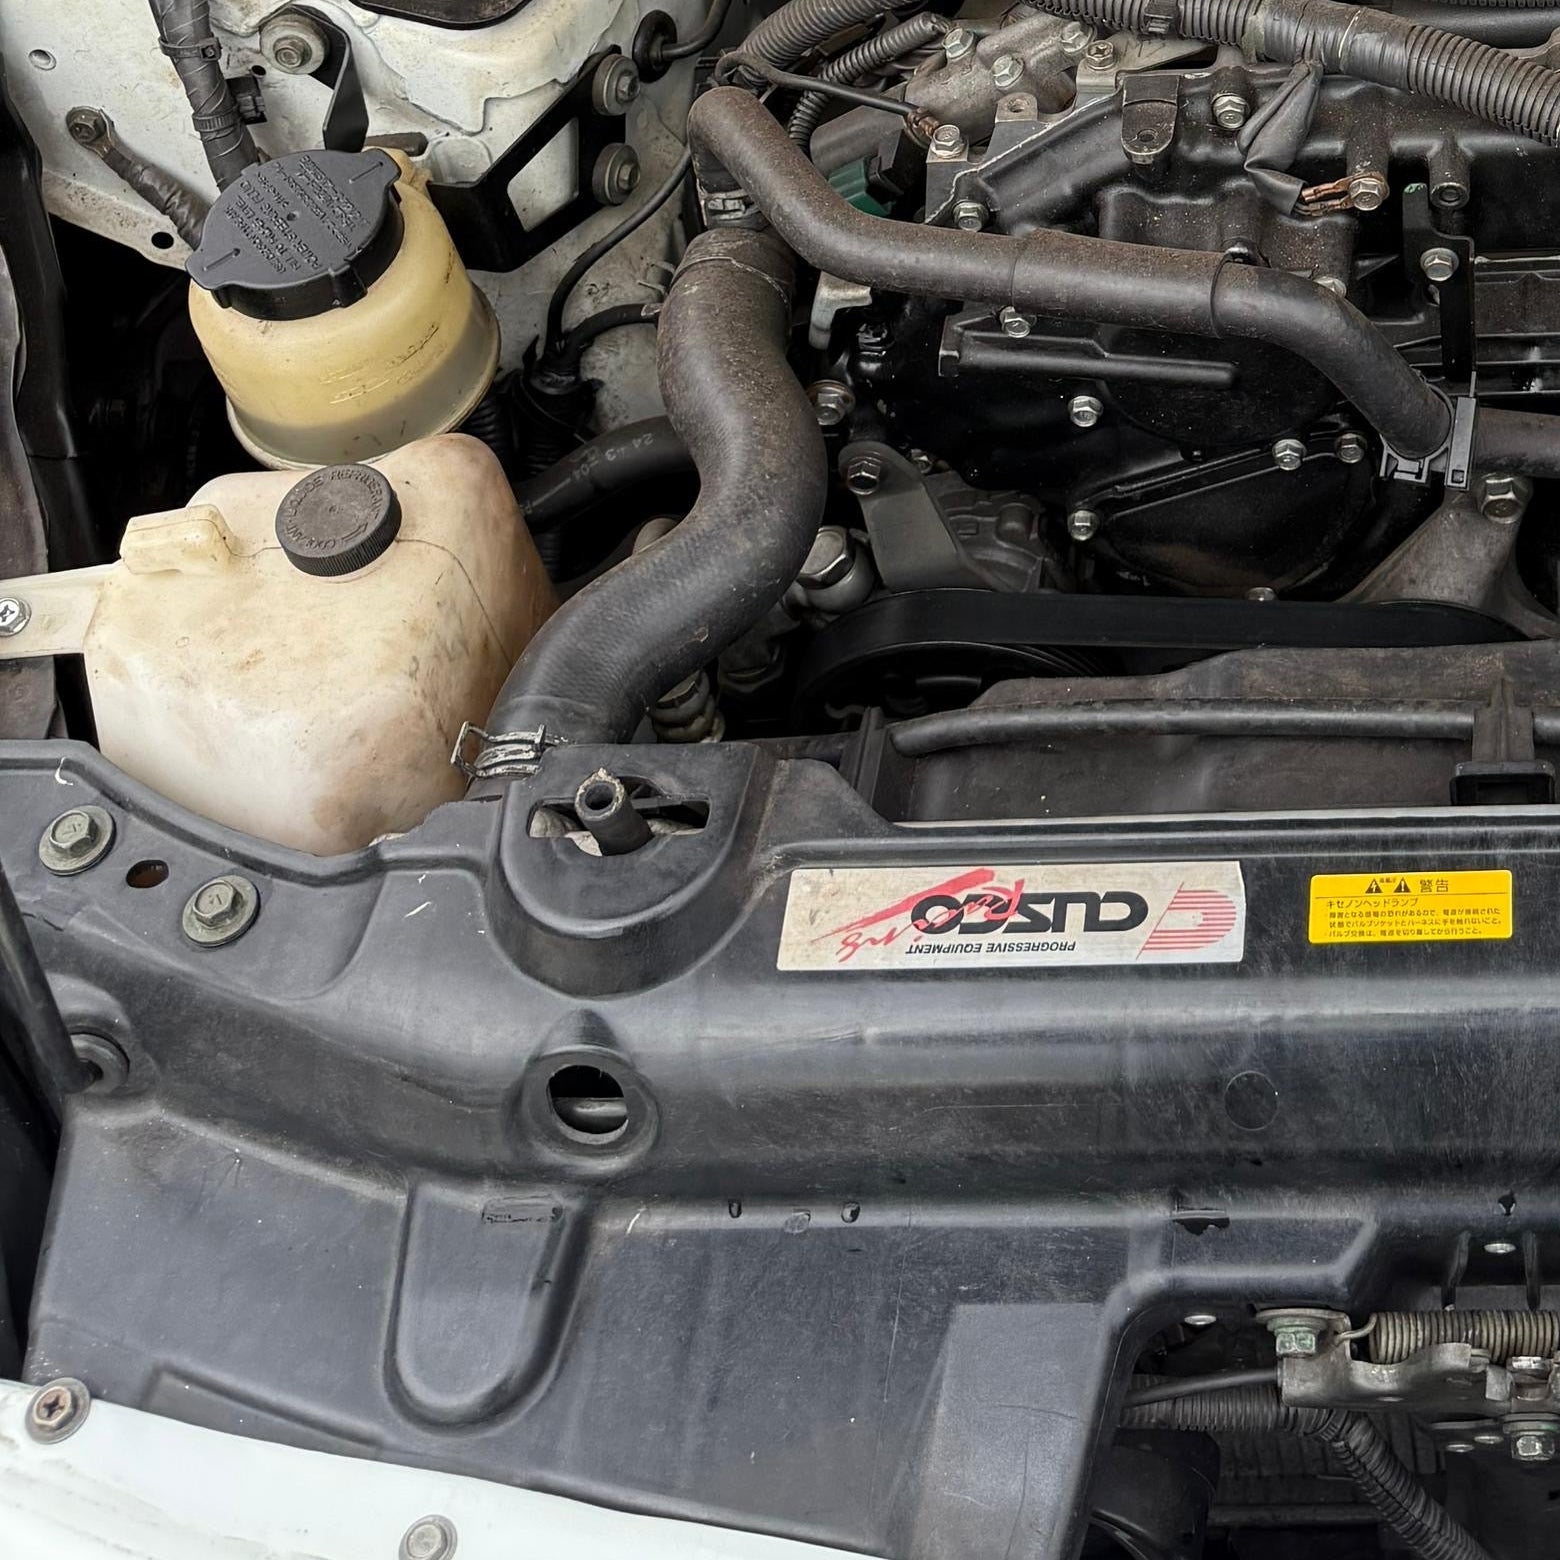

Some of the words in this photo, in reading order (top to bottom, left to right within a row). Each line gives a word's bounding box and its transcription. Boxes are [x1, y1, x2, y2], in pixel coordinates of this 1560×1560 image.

[1419, 878, 1449, 893] 警告
[1327, 898, 1419, 908] キセノンヘッドランプ
[910, 890, 1149, 935] CUSCO
[905, 942, 983, 954] EQUIPMENT
[986, 941, 1076, 953] PROGRESSIVE
